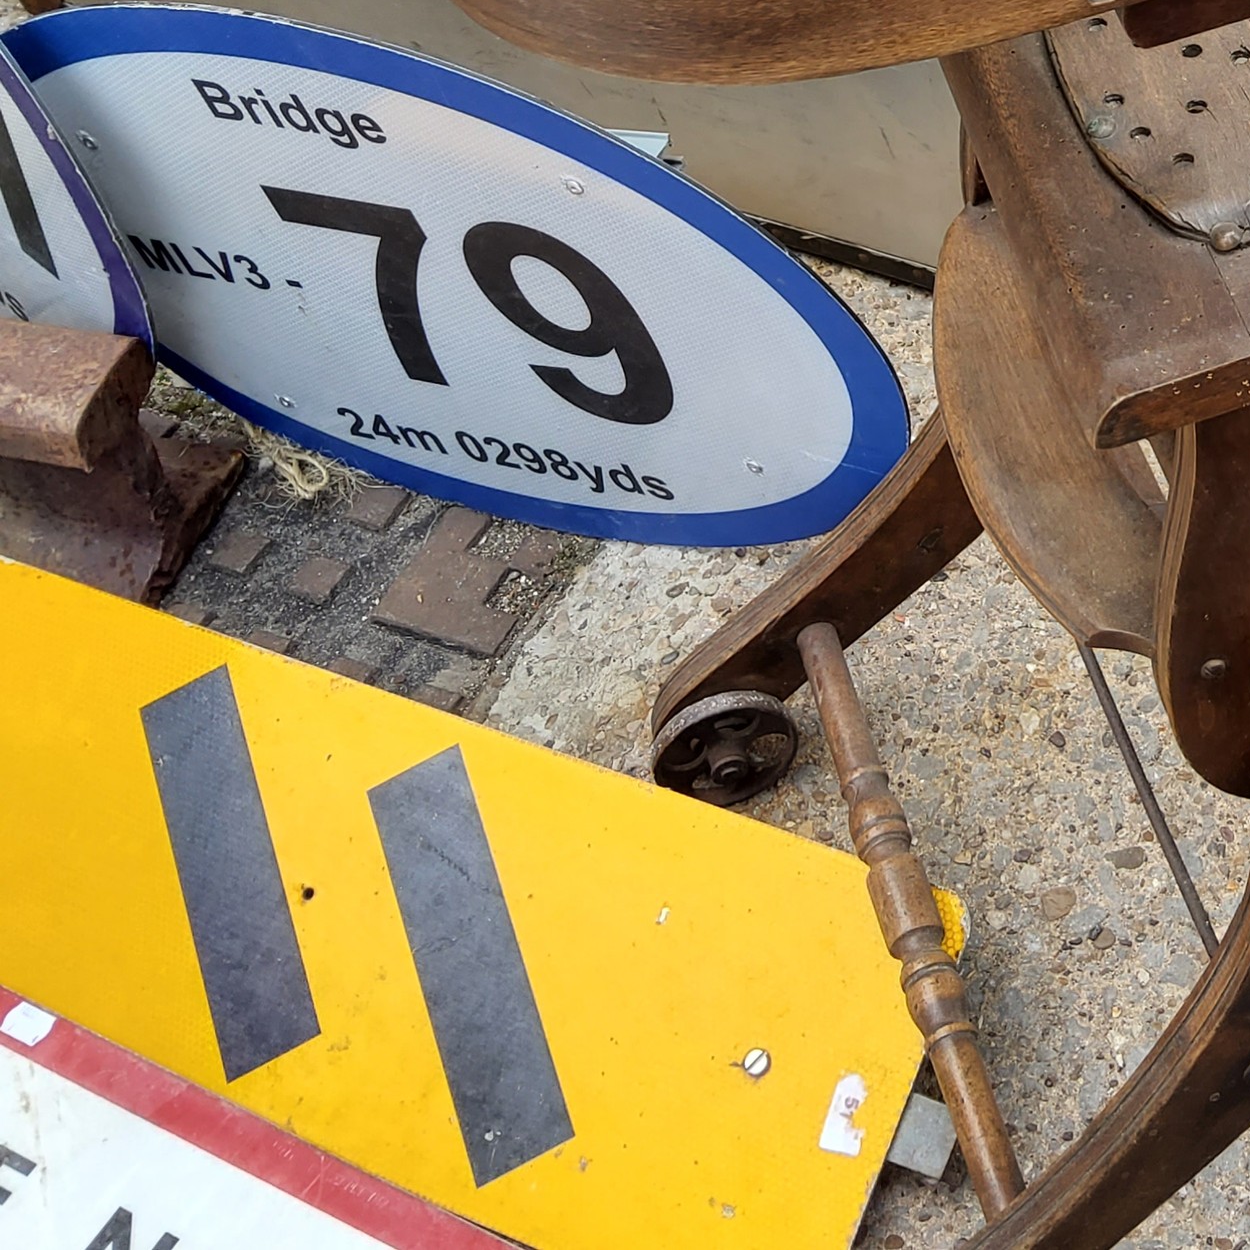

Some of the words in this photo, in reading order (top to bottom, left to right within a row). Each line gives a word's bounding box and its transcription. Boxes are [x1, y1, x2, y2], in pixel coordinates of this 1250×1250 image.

[191, 79, 387, 150] Bridge
[127, 234, 271, 290] MLV3
[260, 184, 675, 426] 79
[336, 407, 448, 455] 24m
[455, 431, 675, 501] 0298yds
